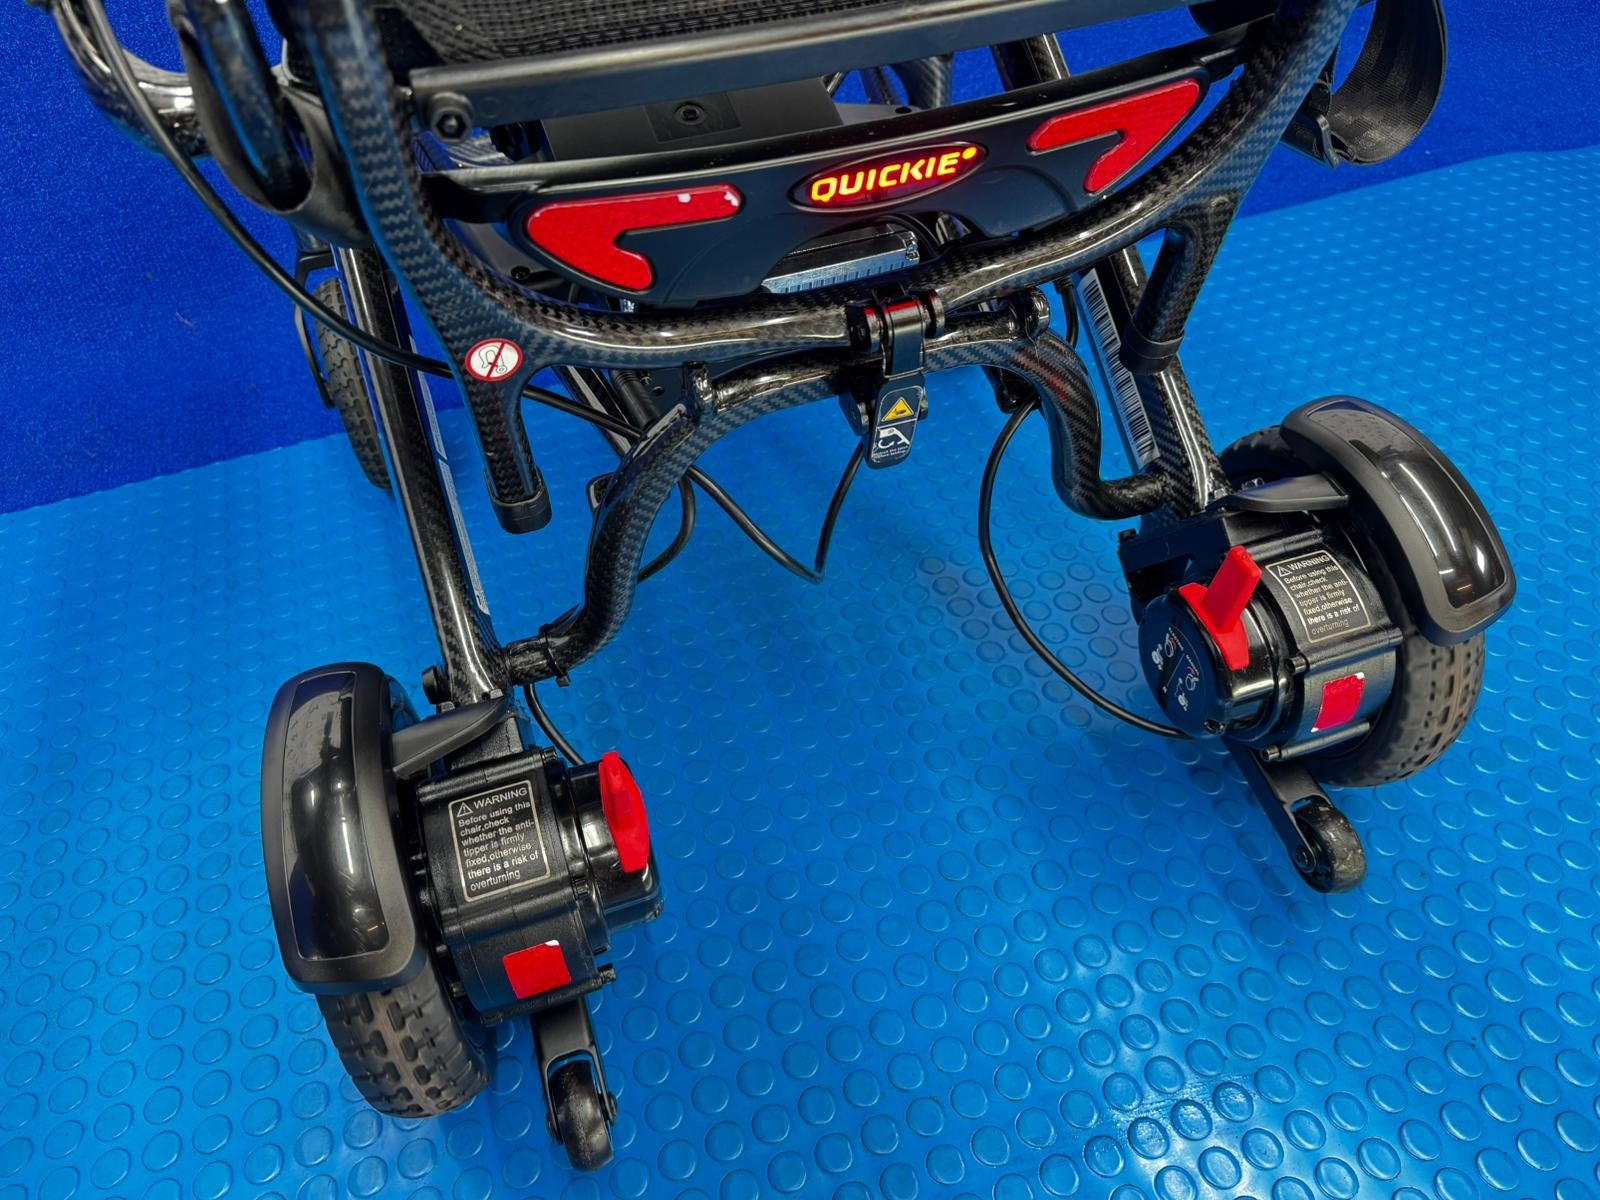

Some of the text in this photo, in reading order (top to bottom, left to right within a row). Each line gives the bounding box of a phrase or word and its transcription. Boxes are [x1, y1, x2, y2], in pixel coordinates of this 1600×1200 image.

[811, 152, 960, 202] QUICKIE
[1288, 555, 1330, 570] WARNING
[1284, 574, 1307, 583] Before
[1308, 568, 1326, 577] using
[1295, 588, 1321, 598] whether
[1327, 589, 1345, 599] firmly
[1308, 615, 1326, 624] there
[1340, 607, 1352, 615] risk
[1312, 619, 1349, 634] overturning
[474, 787, 527, 808] WARNING
[458, 801, 530, 827] Before using this
[462, 830, 496, 846] whether
[498, 825, 512, 835] the
[463, 832, 525, 857] tipper is firmly
[467, 865, 491, 879] there
[493, 863, 501, 871] is
[511, 855, 528, 866] risk
[530, 850, 538, 860] of
[470, 869, 521, 891] overturning
